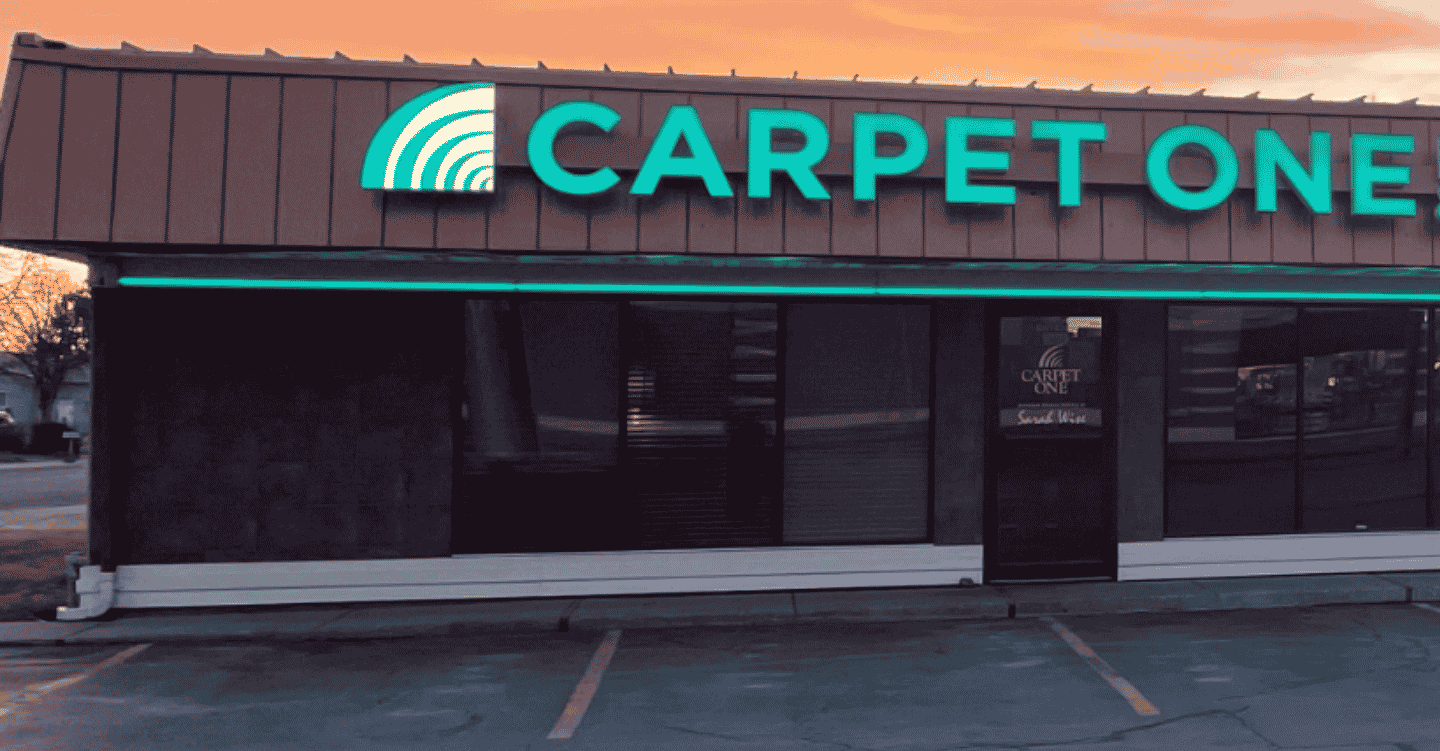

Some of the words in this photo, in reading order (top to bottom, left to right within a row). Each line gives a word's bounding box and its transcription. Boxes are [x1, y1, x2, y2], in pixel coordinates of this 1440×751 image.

[525, 99, 1109, 208] CARPET
[1144, 123, 1418, 217] ONE
[1021, 369, 1081, 382] CARPET
[1034, 380, 1068, 394] ONE
